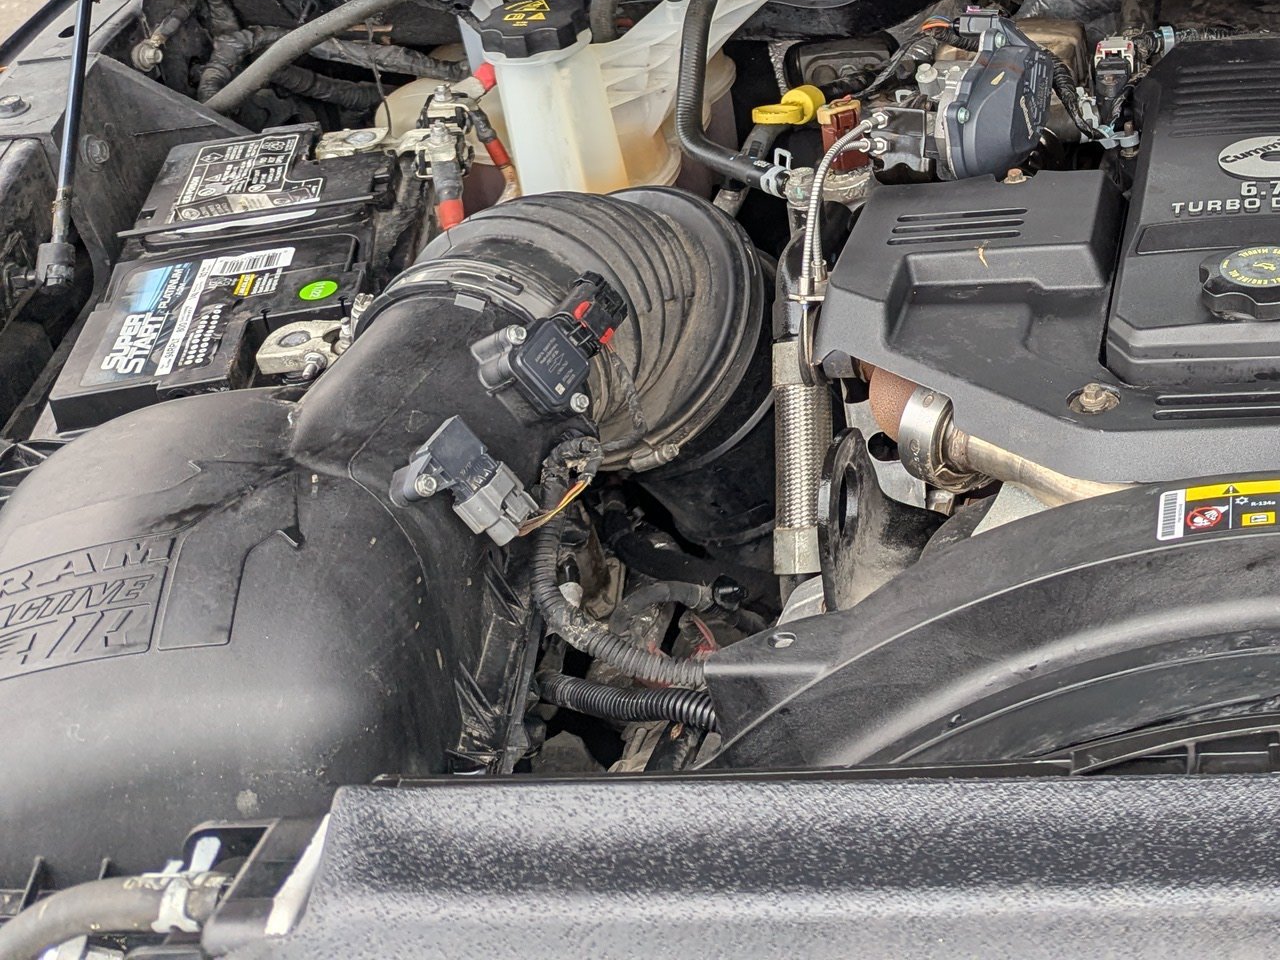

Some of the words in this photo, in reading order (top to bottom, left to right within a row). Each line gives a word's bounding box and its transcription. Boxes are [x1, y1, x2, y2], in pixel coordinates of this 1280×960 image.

[1171, 198, 1261, 214] TURBO
[100, 314, 146, 370] SUPER
[116, 311, 165, 374] START
[157, 267, 184, 309] PLATINUM
[0, 538, 177, 598] RAM
